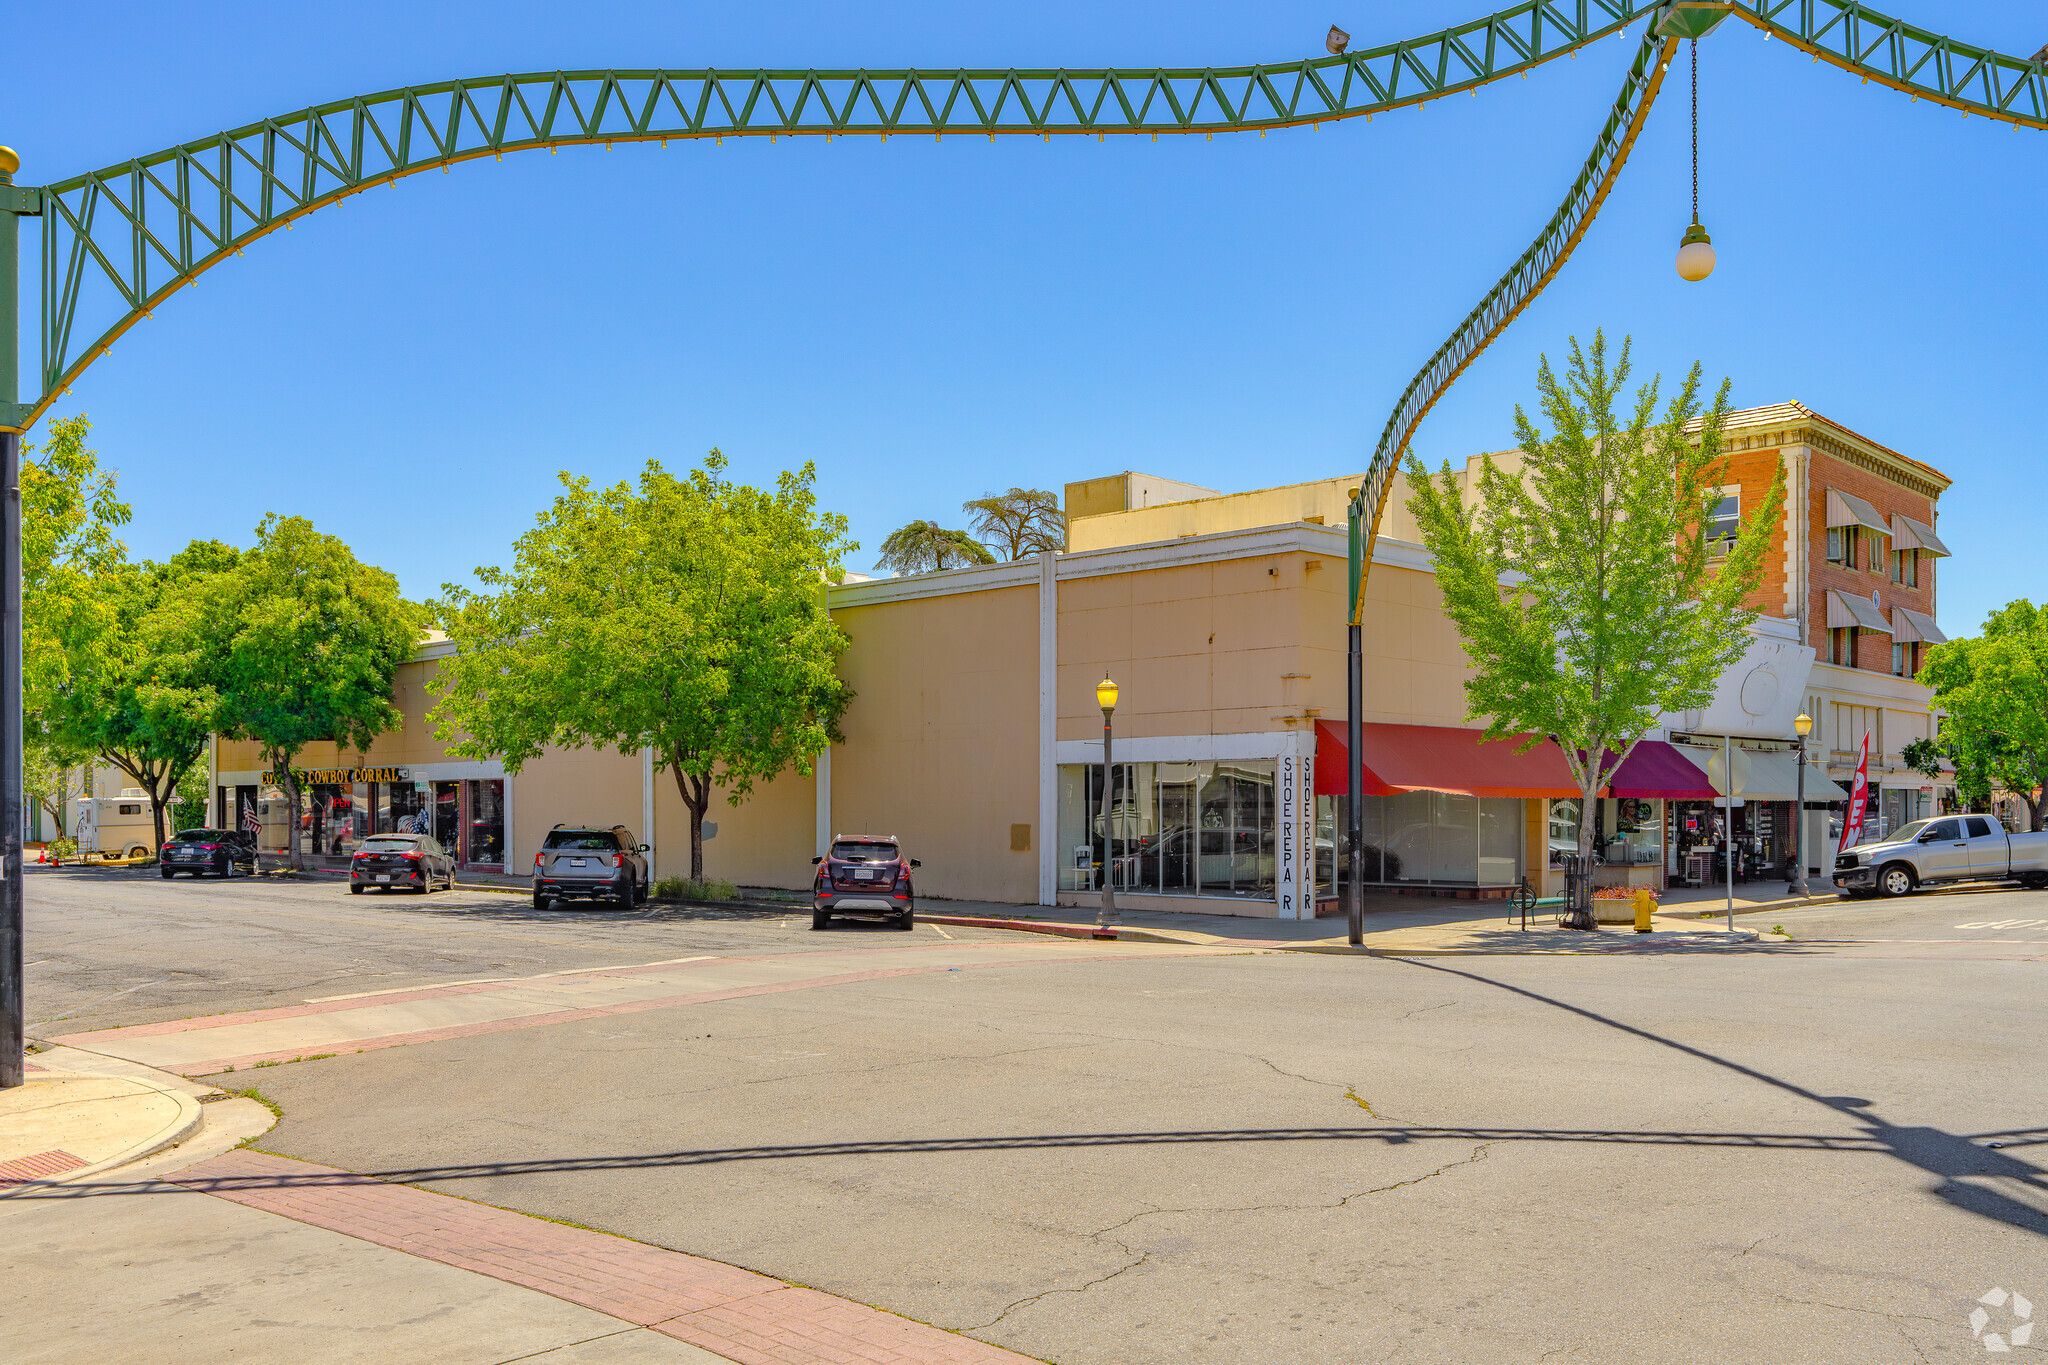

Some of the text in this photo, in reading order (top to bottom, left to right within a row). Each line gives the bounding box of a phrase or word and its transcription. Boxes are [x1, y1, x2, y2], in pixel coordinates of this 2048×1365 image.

[308, 769, 350, 784] COWBOY
[353, 767, 399, 783] CORRAL
[1284, 757, 1293, 818] SHOE
